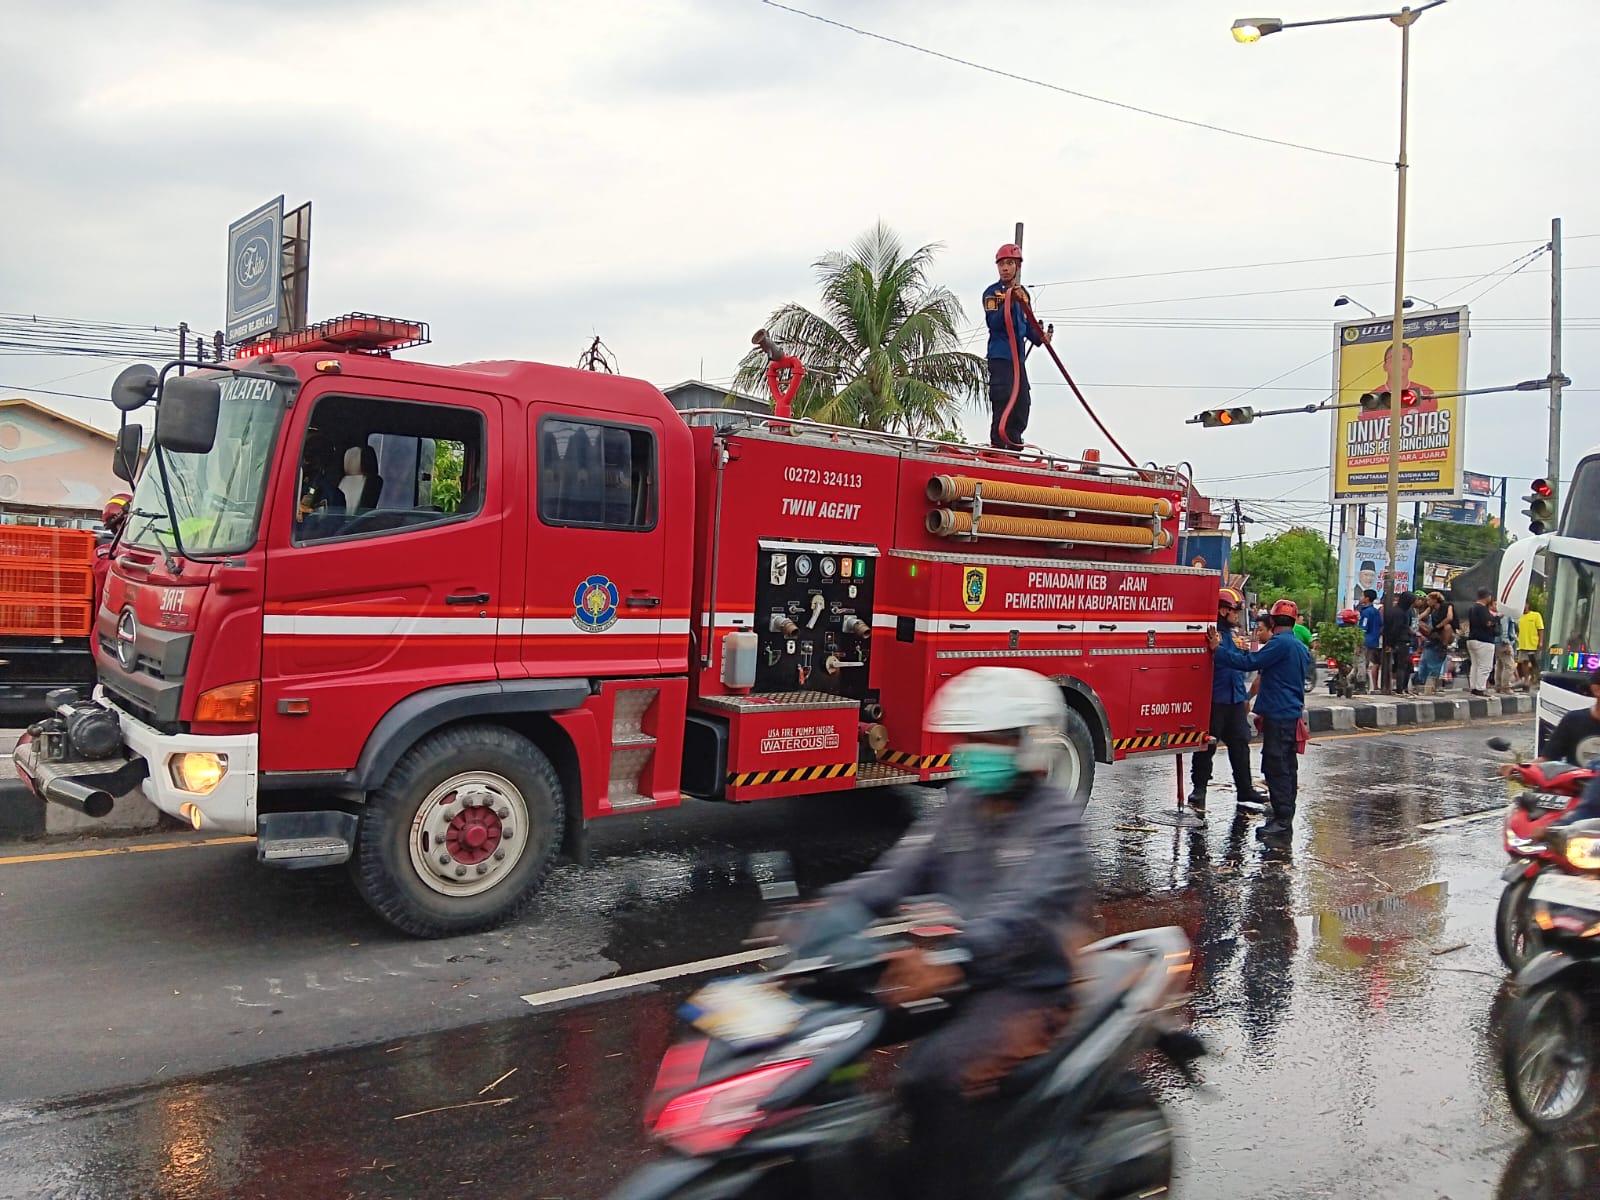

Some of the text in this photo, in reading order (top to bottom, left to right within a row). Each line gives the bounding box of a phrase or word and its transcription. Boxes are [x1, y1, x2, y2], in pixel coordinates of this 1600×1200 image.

[225, 379, 276, 400] KLATEN
[1347, 409, 1450, 443] UNIVESITAS
[1347, 440, 1376, 457] TUNAS
[1348, 456, 1390, 466] KAMPUSNY
[1420, 450, 1446, 460] JUARA
[783, 466, 862, 489] (0272) 324113
[781, 498, 861, 521] TWIN AGENT
[1028, 571, 1084, 590] PEMADAM
[1005, 592, 1174, 612] PEMERINTAH KABUPATEN KLATEN
[1140, 701, 1193, 717] FE 5000 TW DC
[768, 725, 834, 738] USA FIRE PUMPS INSIDE
[763, 737, 823, 752] WATEROUS
